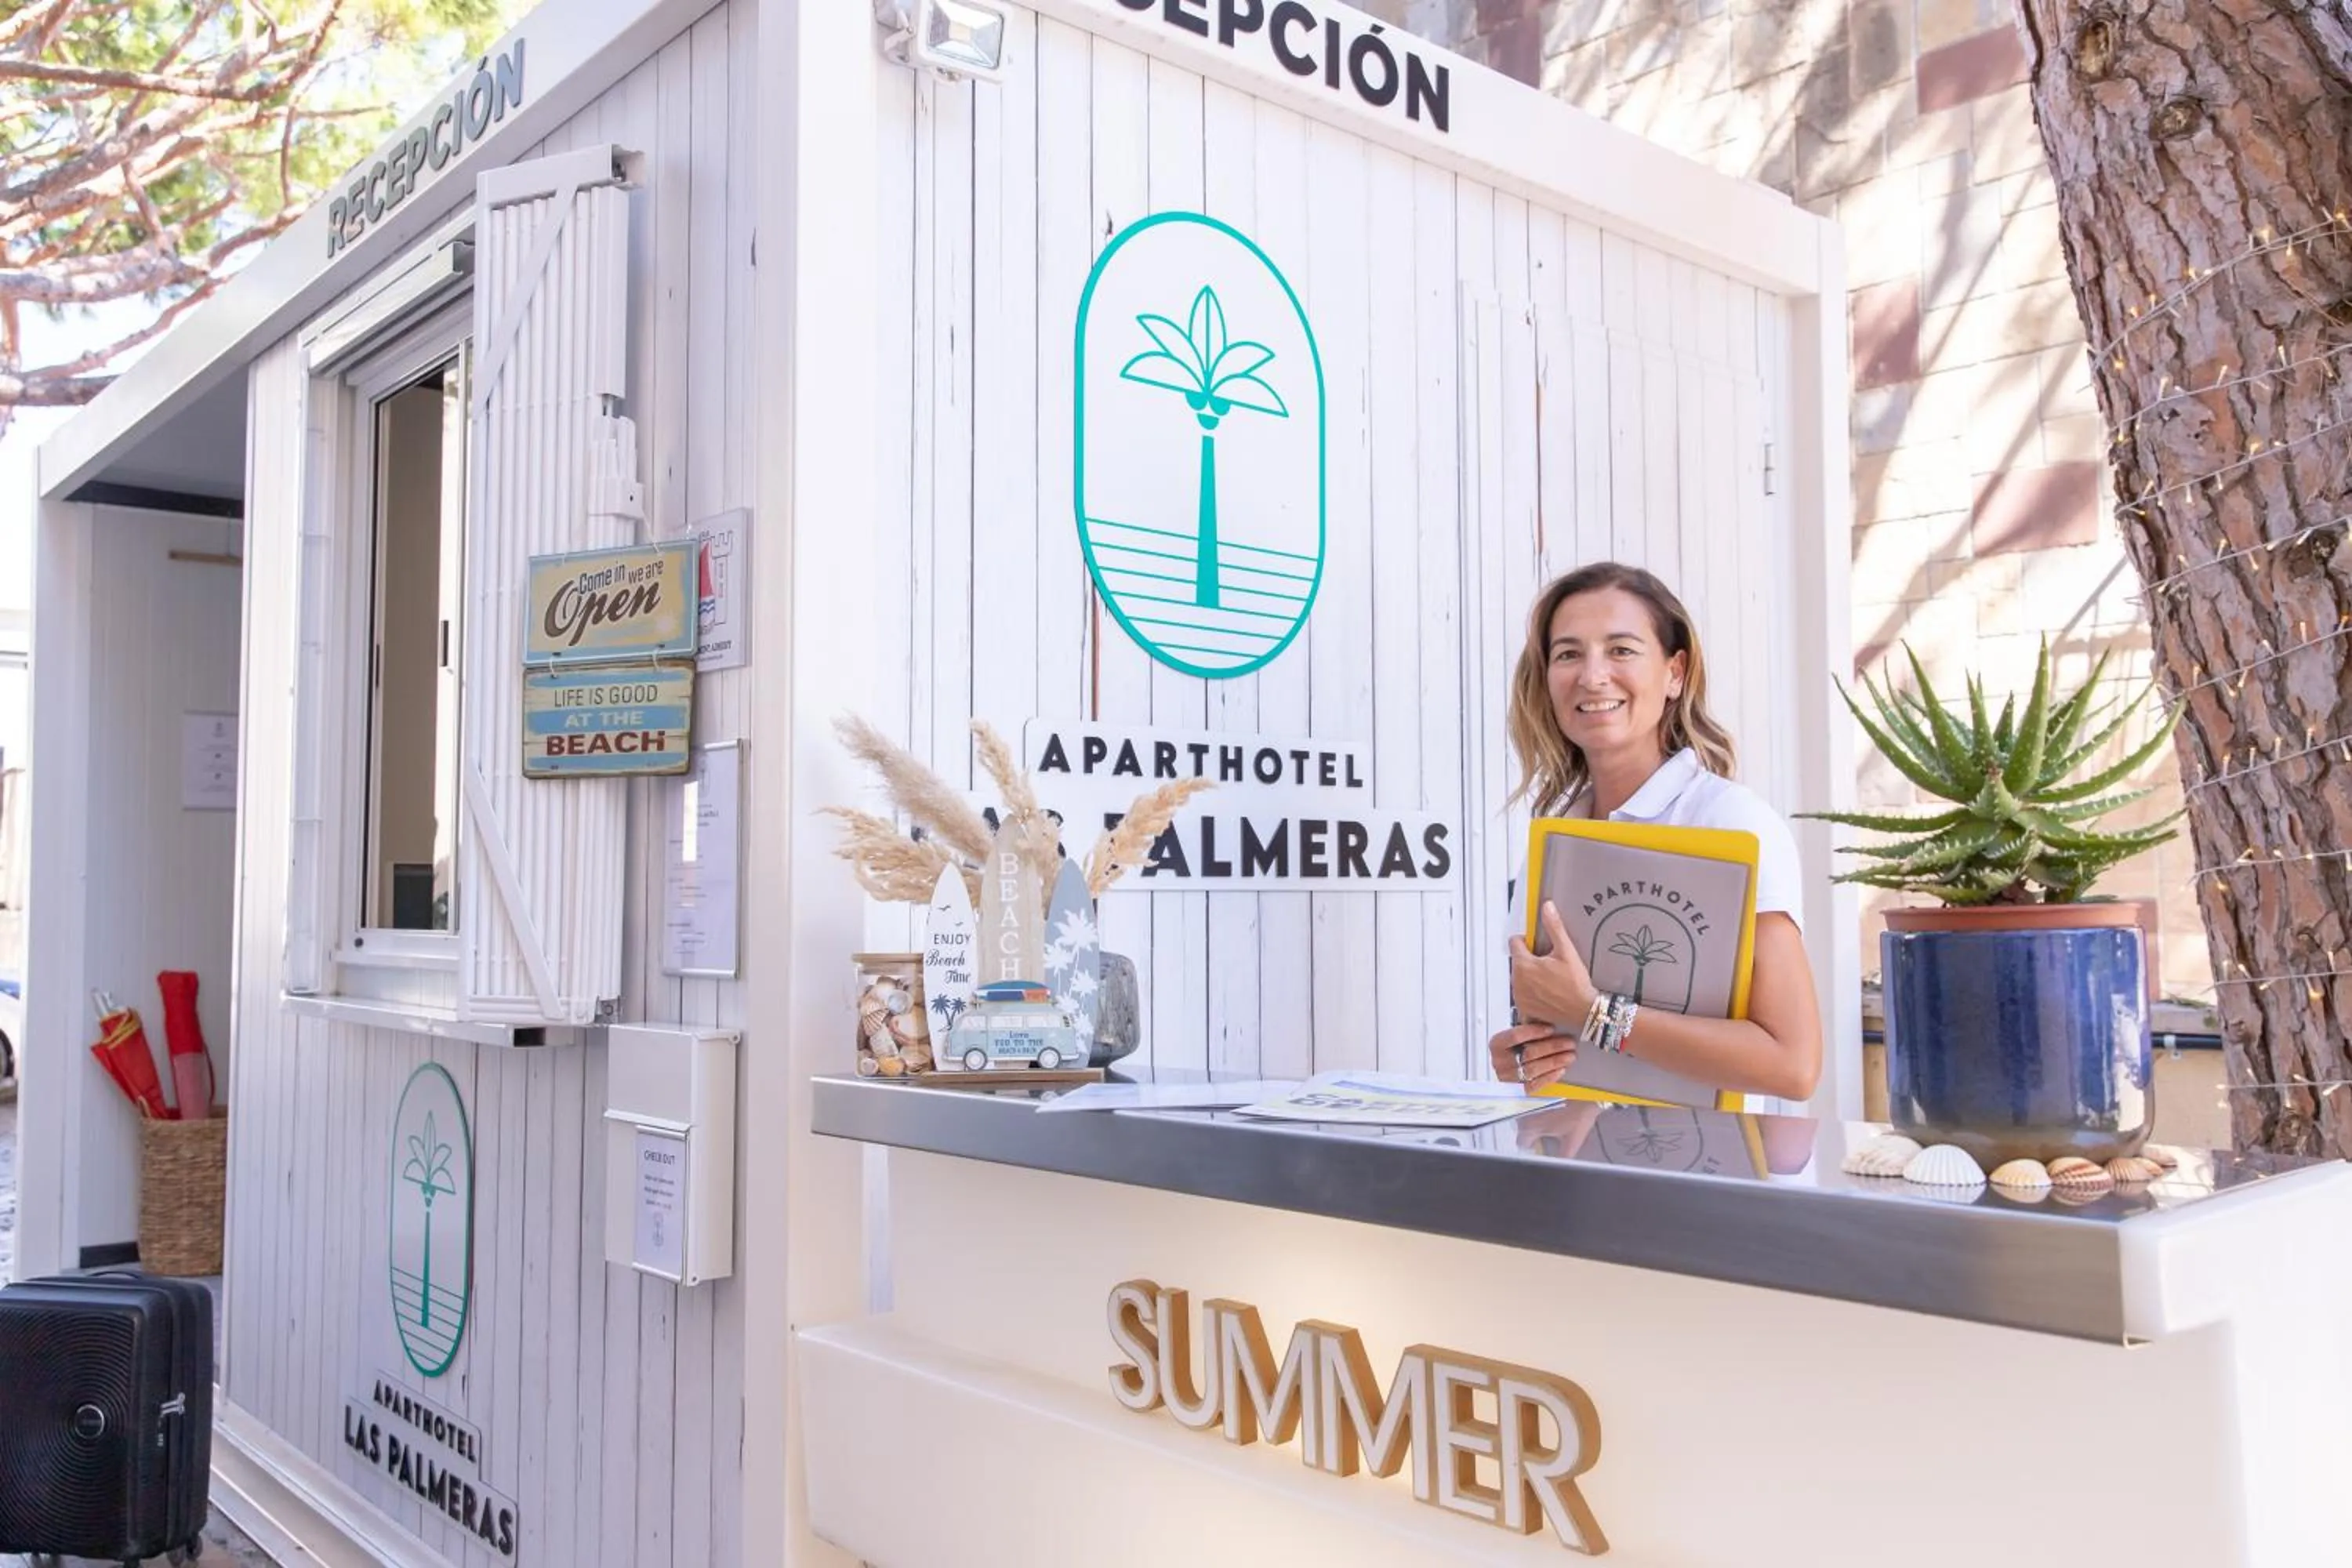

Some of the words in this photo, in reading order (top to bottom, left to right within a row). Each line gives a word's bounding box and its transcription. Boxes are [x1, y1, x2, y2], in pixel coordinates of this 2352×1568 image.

[1116, 0, 1450, 133] PCIÓN
[327, 38, 525, 258] RECEPCIÓN
[579, 568, 612, 594] Come
[615, 561, 625, 583] in
[628, 567, 644, 584] we
[645, 560, 663, 579] are
[544, 580, 661, 646] Open
[554, 688, 584, 707] LIFE
[590, 688, 603, 705] IS
[609, 684, 658, 704] GOOD
[564, 713, 592, 728] AT
[599, 710, 644, 726] THE
[546, 730, 666, 756] BEACH
[1039, 733, 1363, 788] APARTHOTEL
[1104, 812, 1451, 879] ALMERAS
[999, 852, 1021, 981] BEACH
[1582, 880, 1711, 935] APARTHOTEL
[926, 949, 965, 966] Beach
[934, 934, 971, 945] ENJOY
[945, 969, 971, 984] Time
[373, 1379, 477, 1463] APARTHOTEL
[1108, 1279, 1610, 1555] SUMMER
[344, 1404, 381, 1465] LAS
[389, 1434, 514, 1556] PALMERAS
